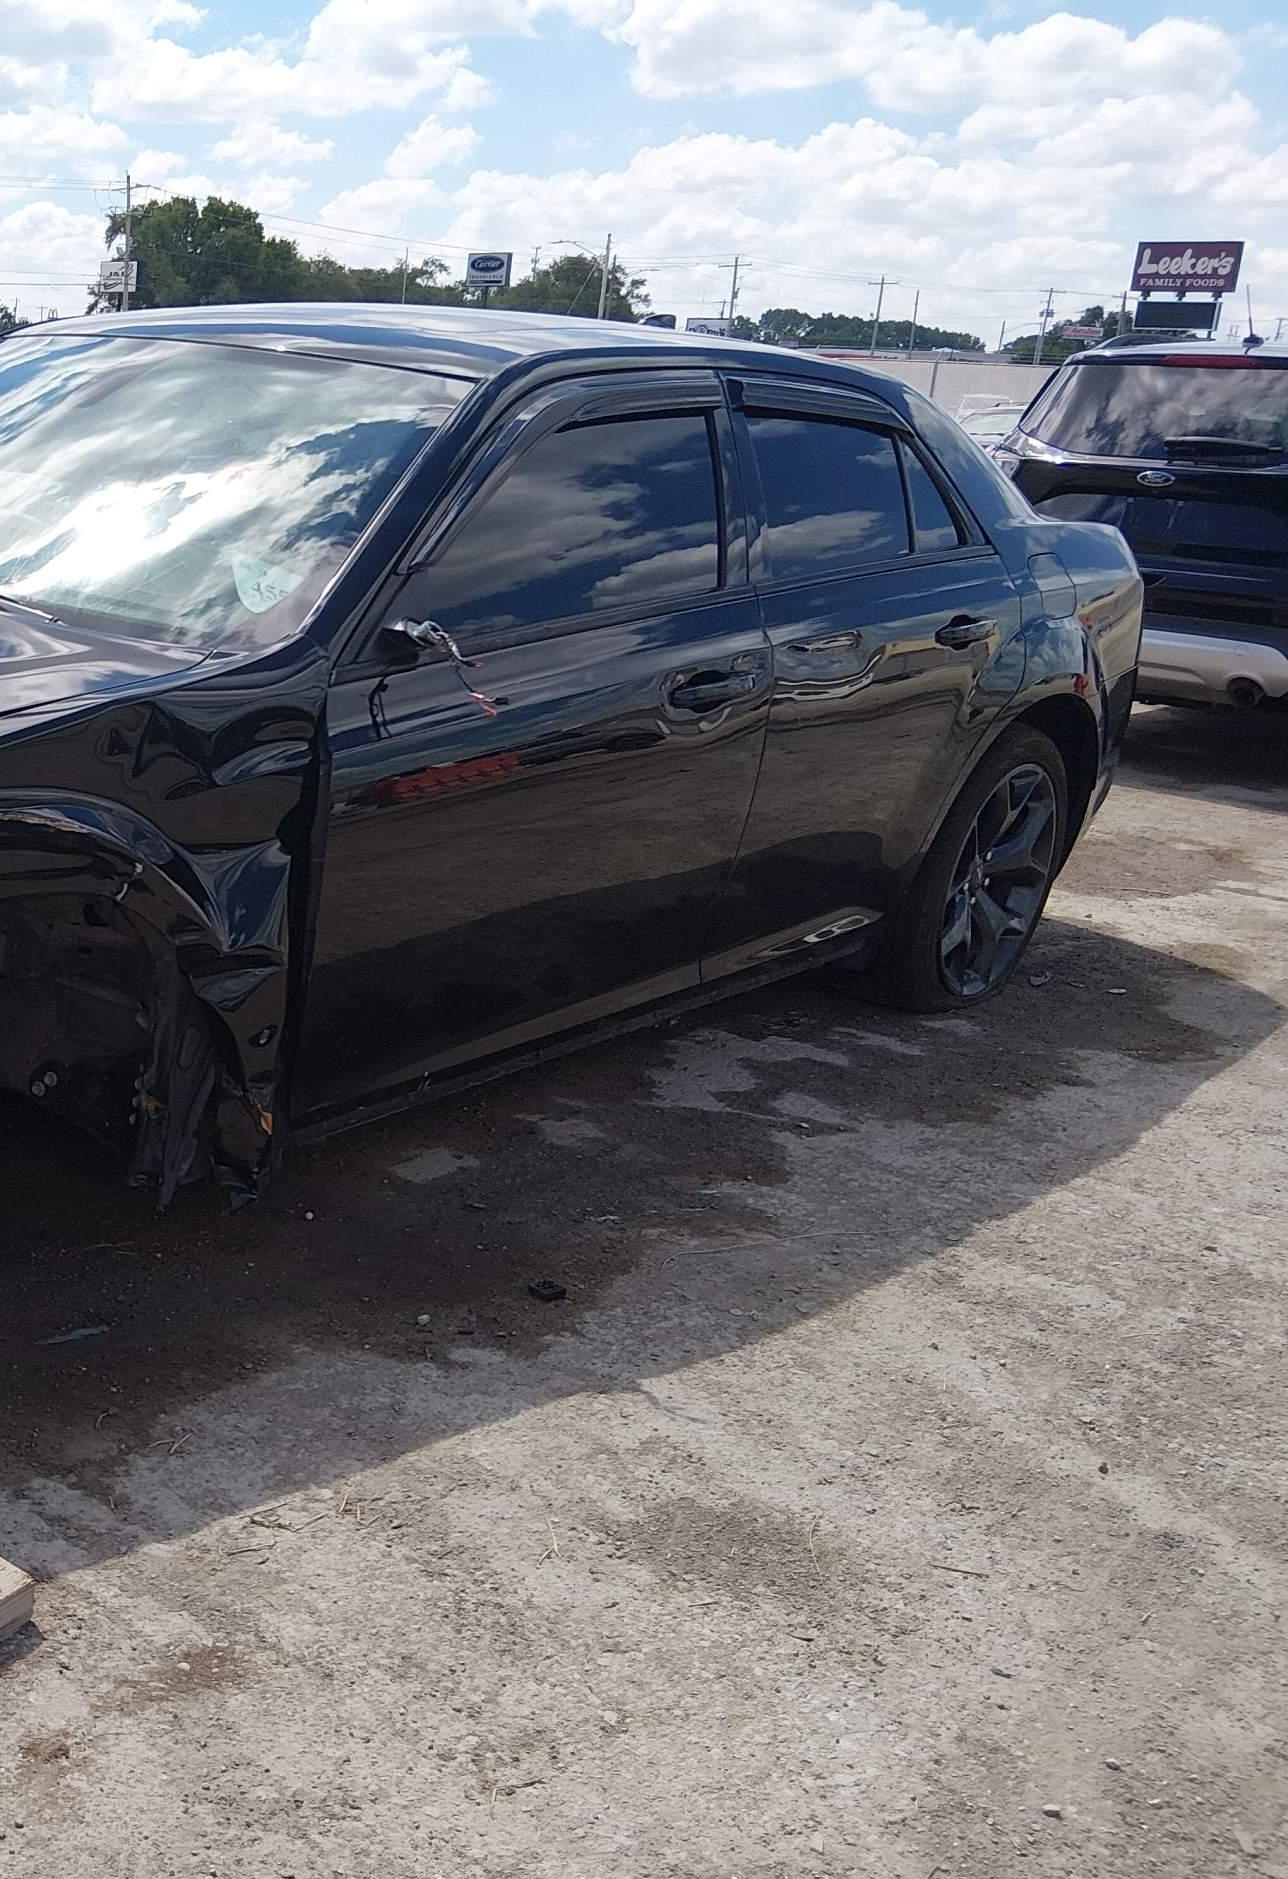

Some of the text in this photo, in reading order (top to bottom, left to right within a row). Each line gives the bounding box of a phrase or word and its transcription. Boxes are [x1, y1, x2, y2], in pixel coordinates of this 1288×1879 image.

[1137, 248, 1235, 275] Leeker's
[1139, 278, 1225, 287] FAMILY FOODS
